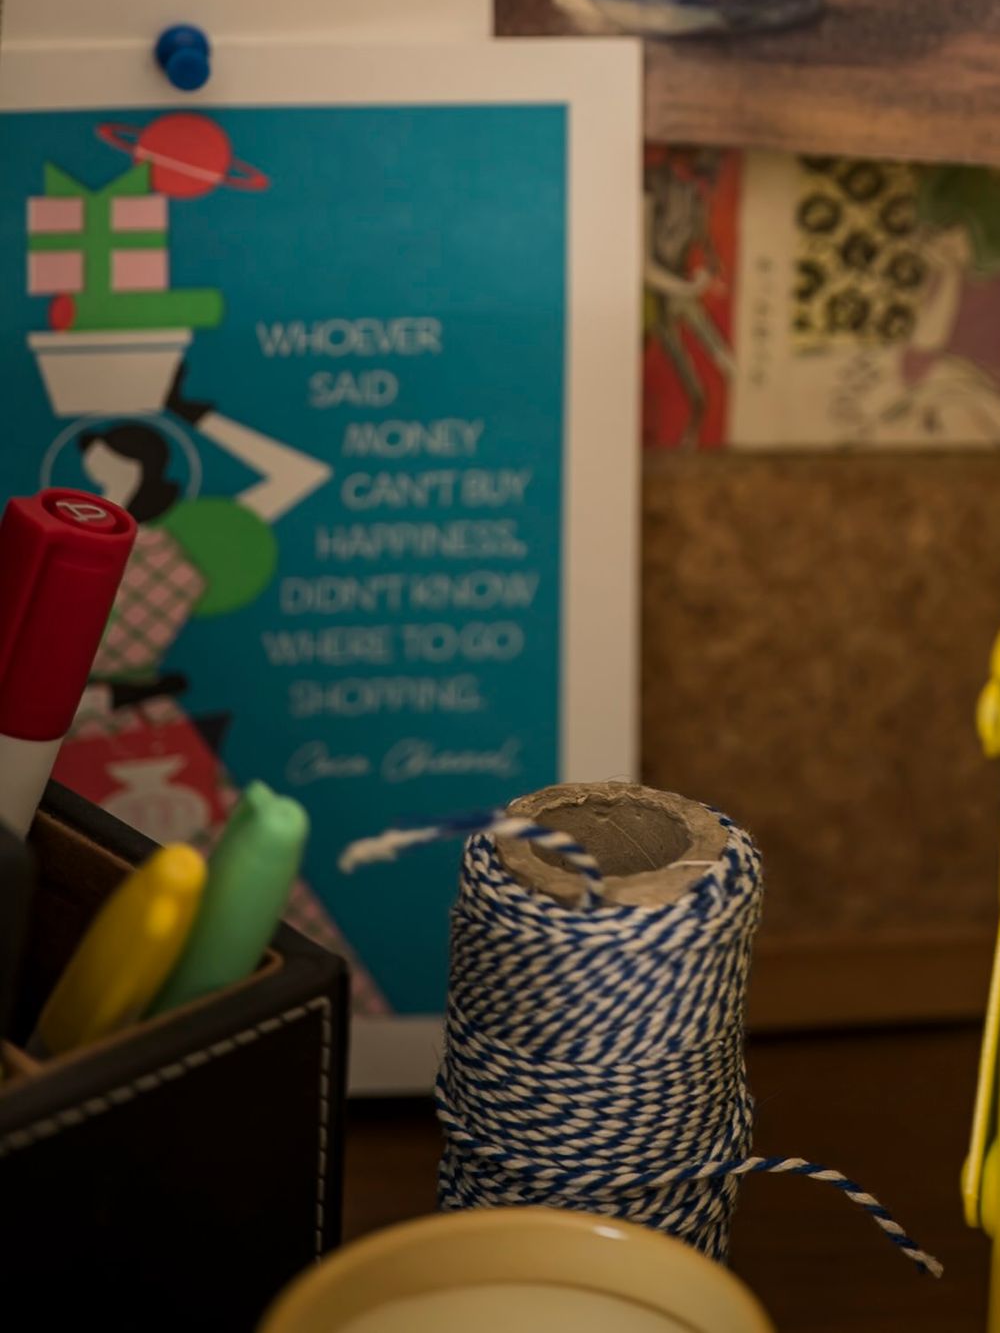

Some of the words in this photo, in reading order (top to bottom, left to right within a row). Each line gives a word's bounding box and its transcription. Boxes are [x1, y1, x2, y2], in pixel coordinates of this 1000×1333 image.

[257, 318, 443, 356] WHOEVER
[308, 369, 398, 409] SAID
[341, 418, 485, 458] MONEY
[459, 466, 535, 507] BUY
[407, 570, 540, 610] KNOW
[261, 624, 393, 665] WHERE
[400, 622, 459, 663] TO
[459, 621, 524, 662] GO
